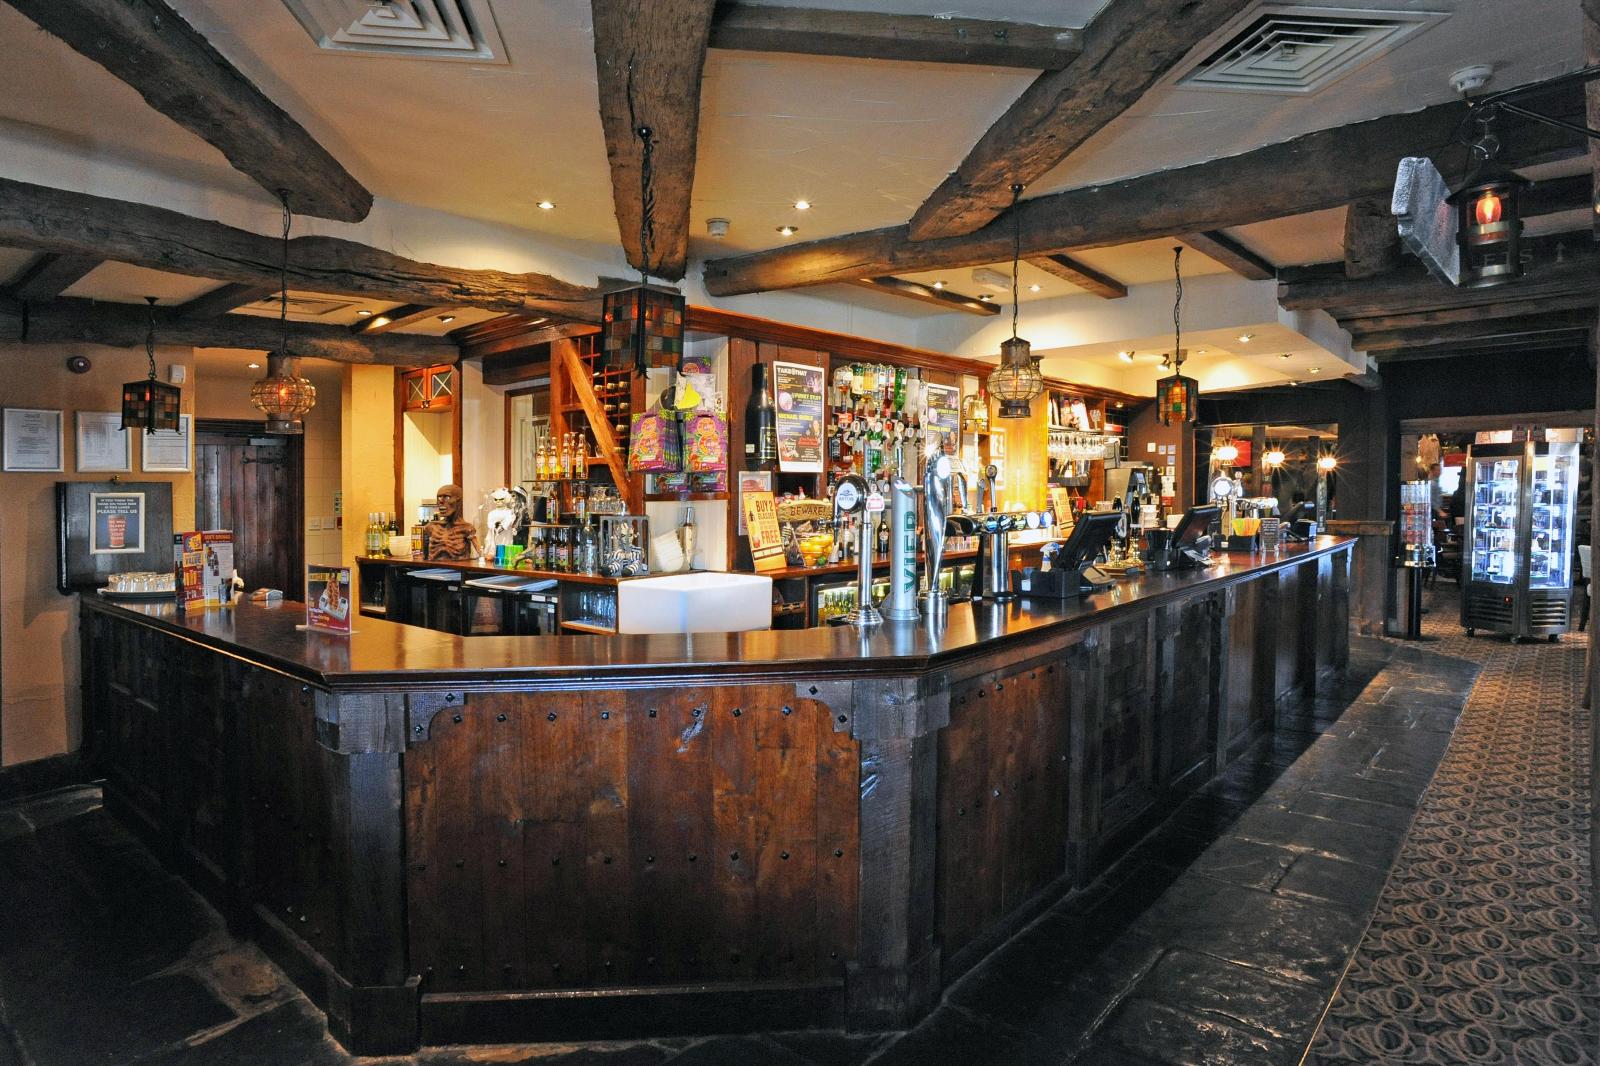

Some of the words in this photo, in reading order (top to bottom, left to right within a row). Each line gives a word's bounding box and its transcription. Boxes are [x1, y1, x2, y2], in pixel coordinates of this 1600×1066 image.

[755, 500, 769, 512] BUY
[790, 506, 826, 517] BEWARE!
[761, 530, 780, 544] FREE
